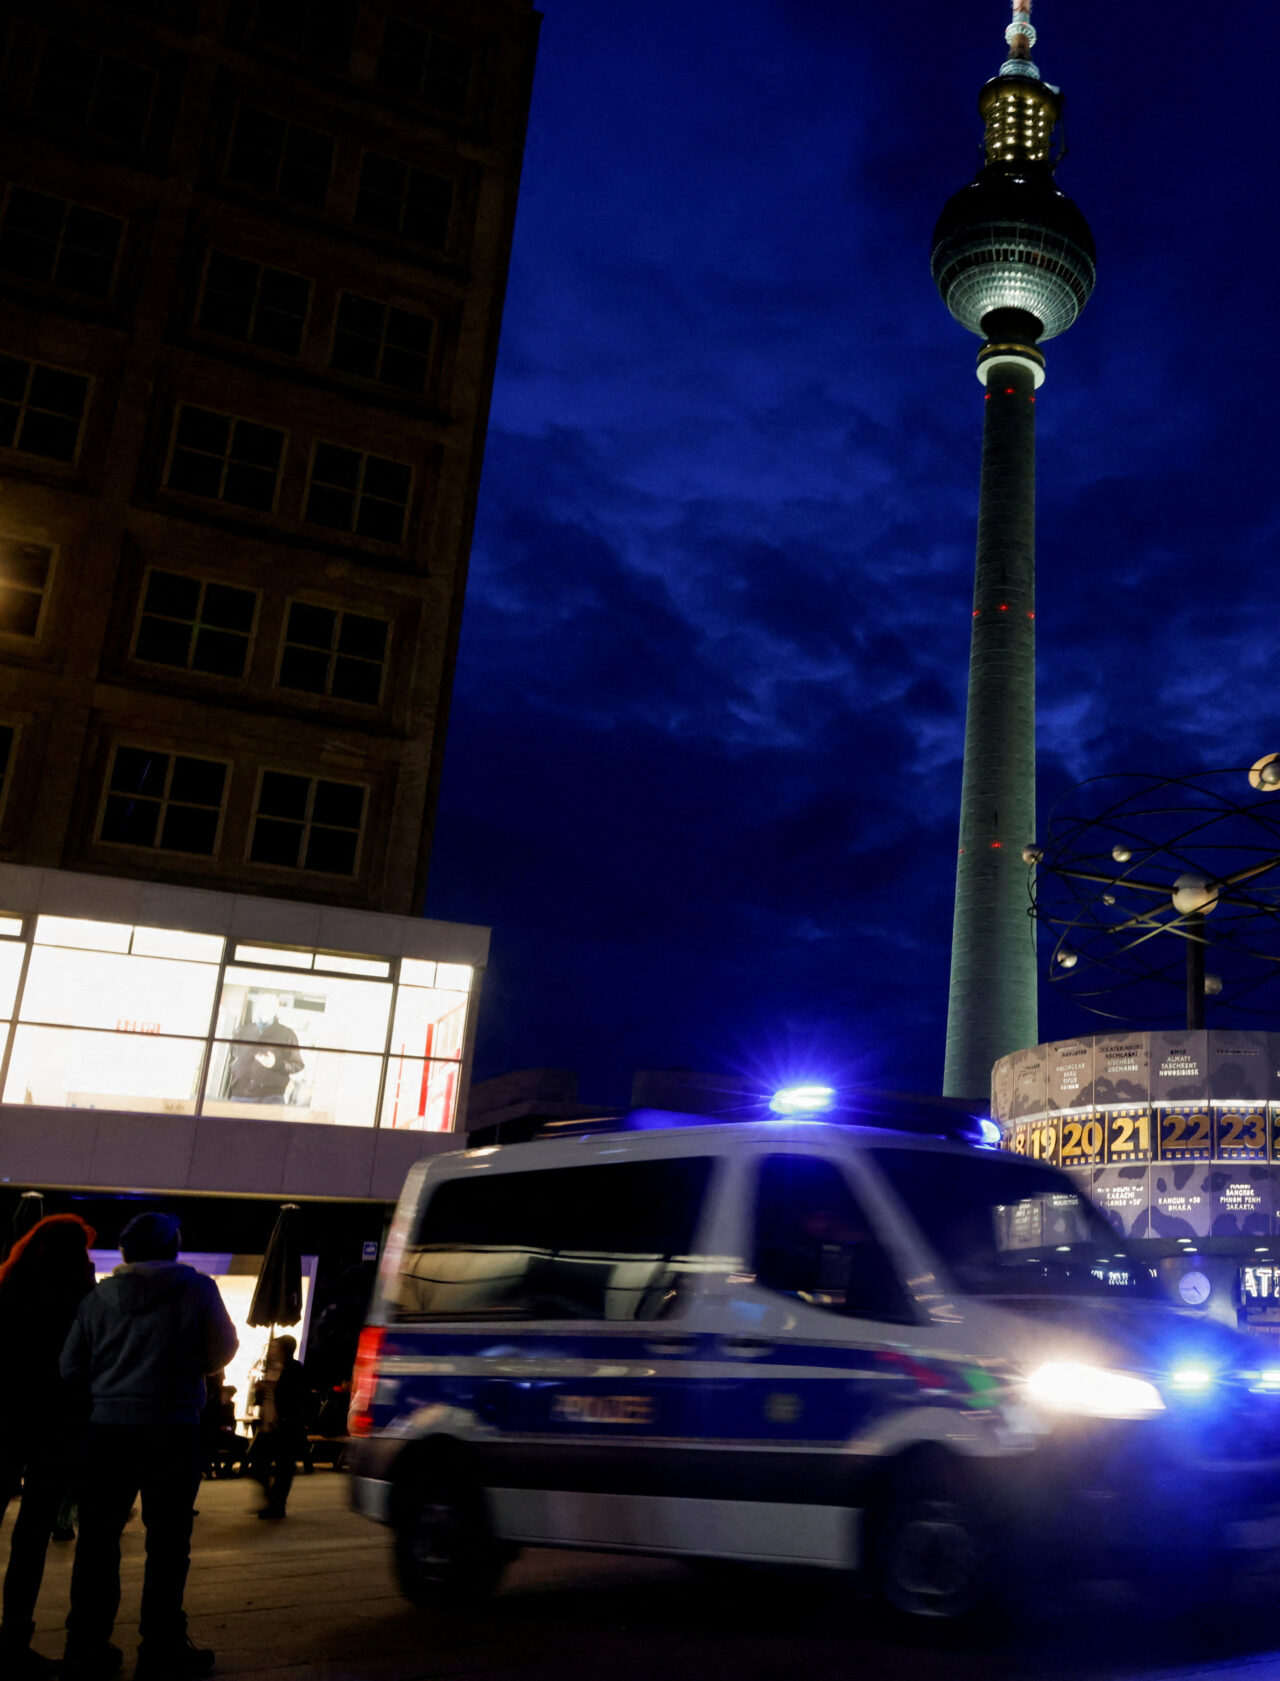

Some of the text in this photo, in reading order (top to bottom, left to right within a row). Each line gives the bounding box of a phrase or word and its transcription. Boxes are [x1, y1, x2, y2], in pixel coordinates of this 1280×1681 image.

[1031, 1126, 1057, 1160] 19
[1061, 1121, 1104, 1157] 20
[1110, 1116, 1150, 1152] 21
[1161, 1114, 1210, 1149] 22
[1219, 1114, 1266, 1149] 23
[1106, 1191, 1135, 1200] KARACHI
[1158, 1197, 1186, 1205] RANGUN
